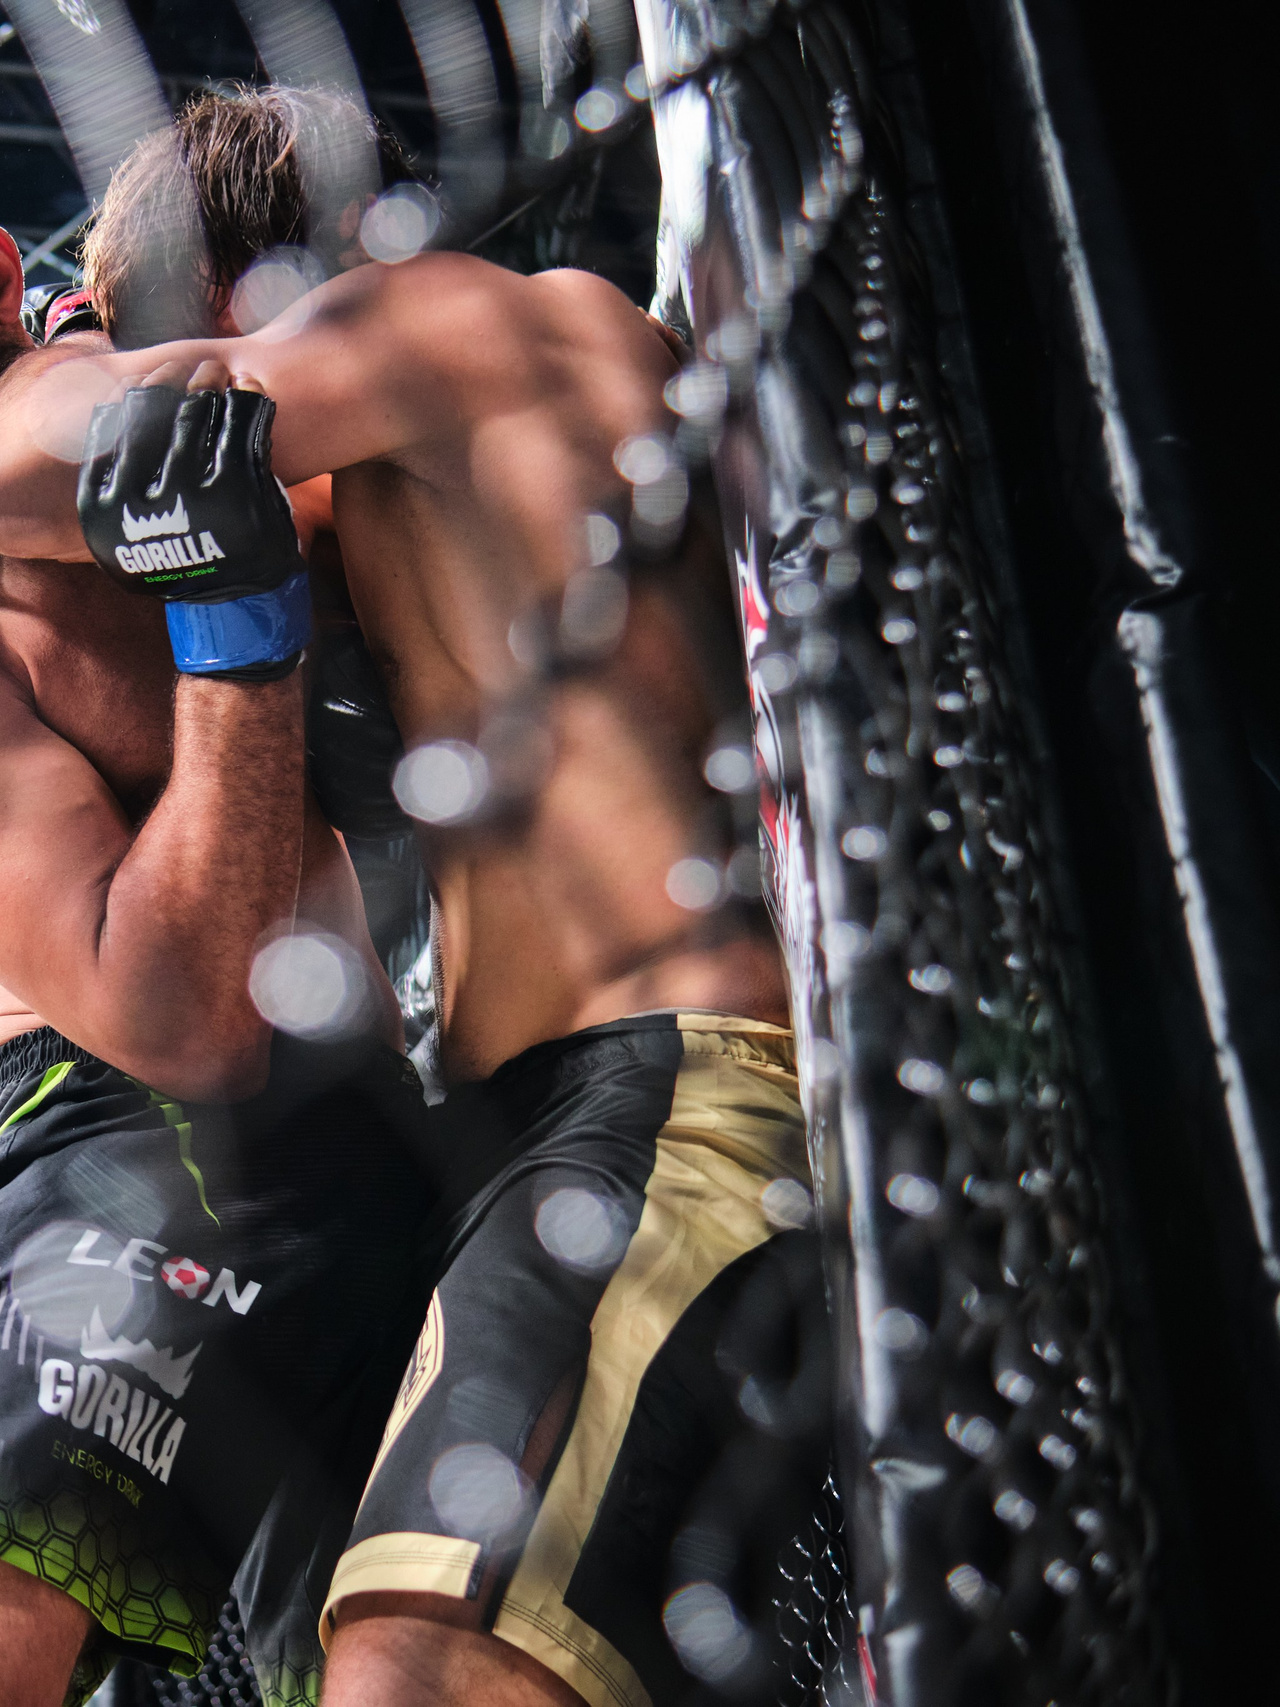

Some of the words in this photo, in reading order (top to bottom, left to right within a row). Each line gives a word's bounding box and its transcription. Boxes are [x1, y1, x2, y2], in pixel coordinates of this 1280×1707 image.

[115, 531, 226, 573] GORILLA
[144, 573, 184, 583] ENERGY
[185, 566, 219, 578] DRINK
[38, 1358, 187, 1487] GORILLA
[51, 1440, 113, 1485] ENERGY
